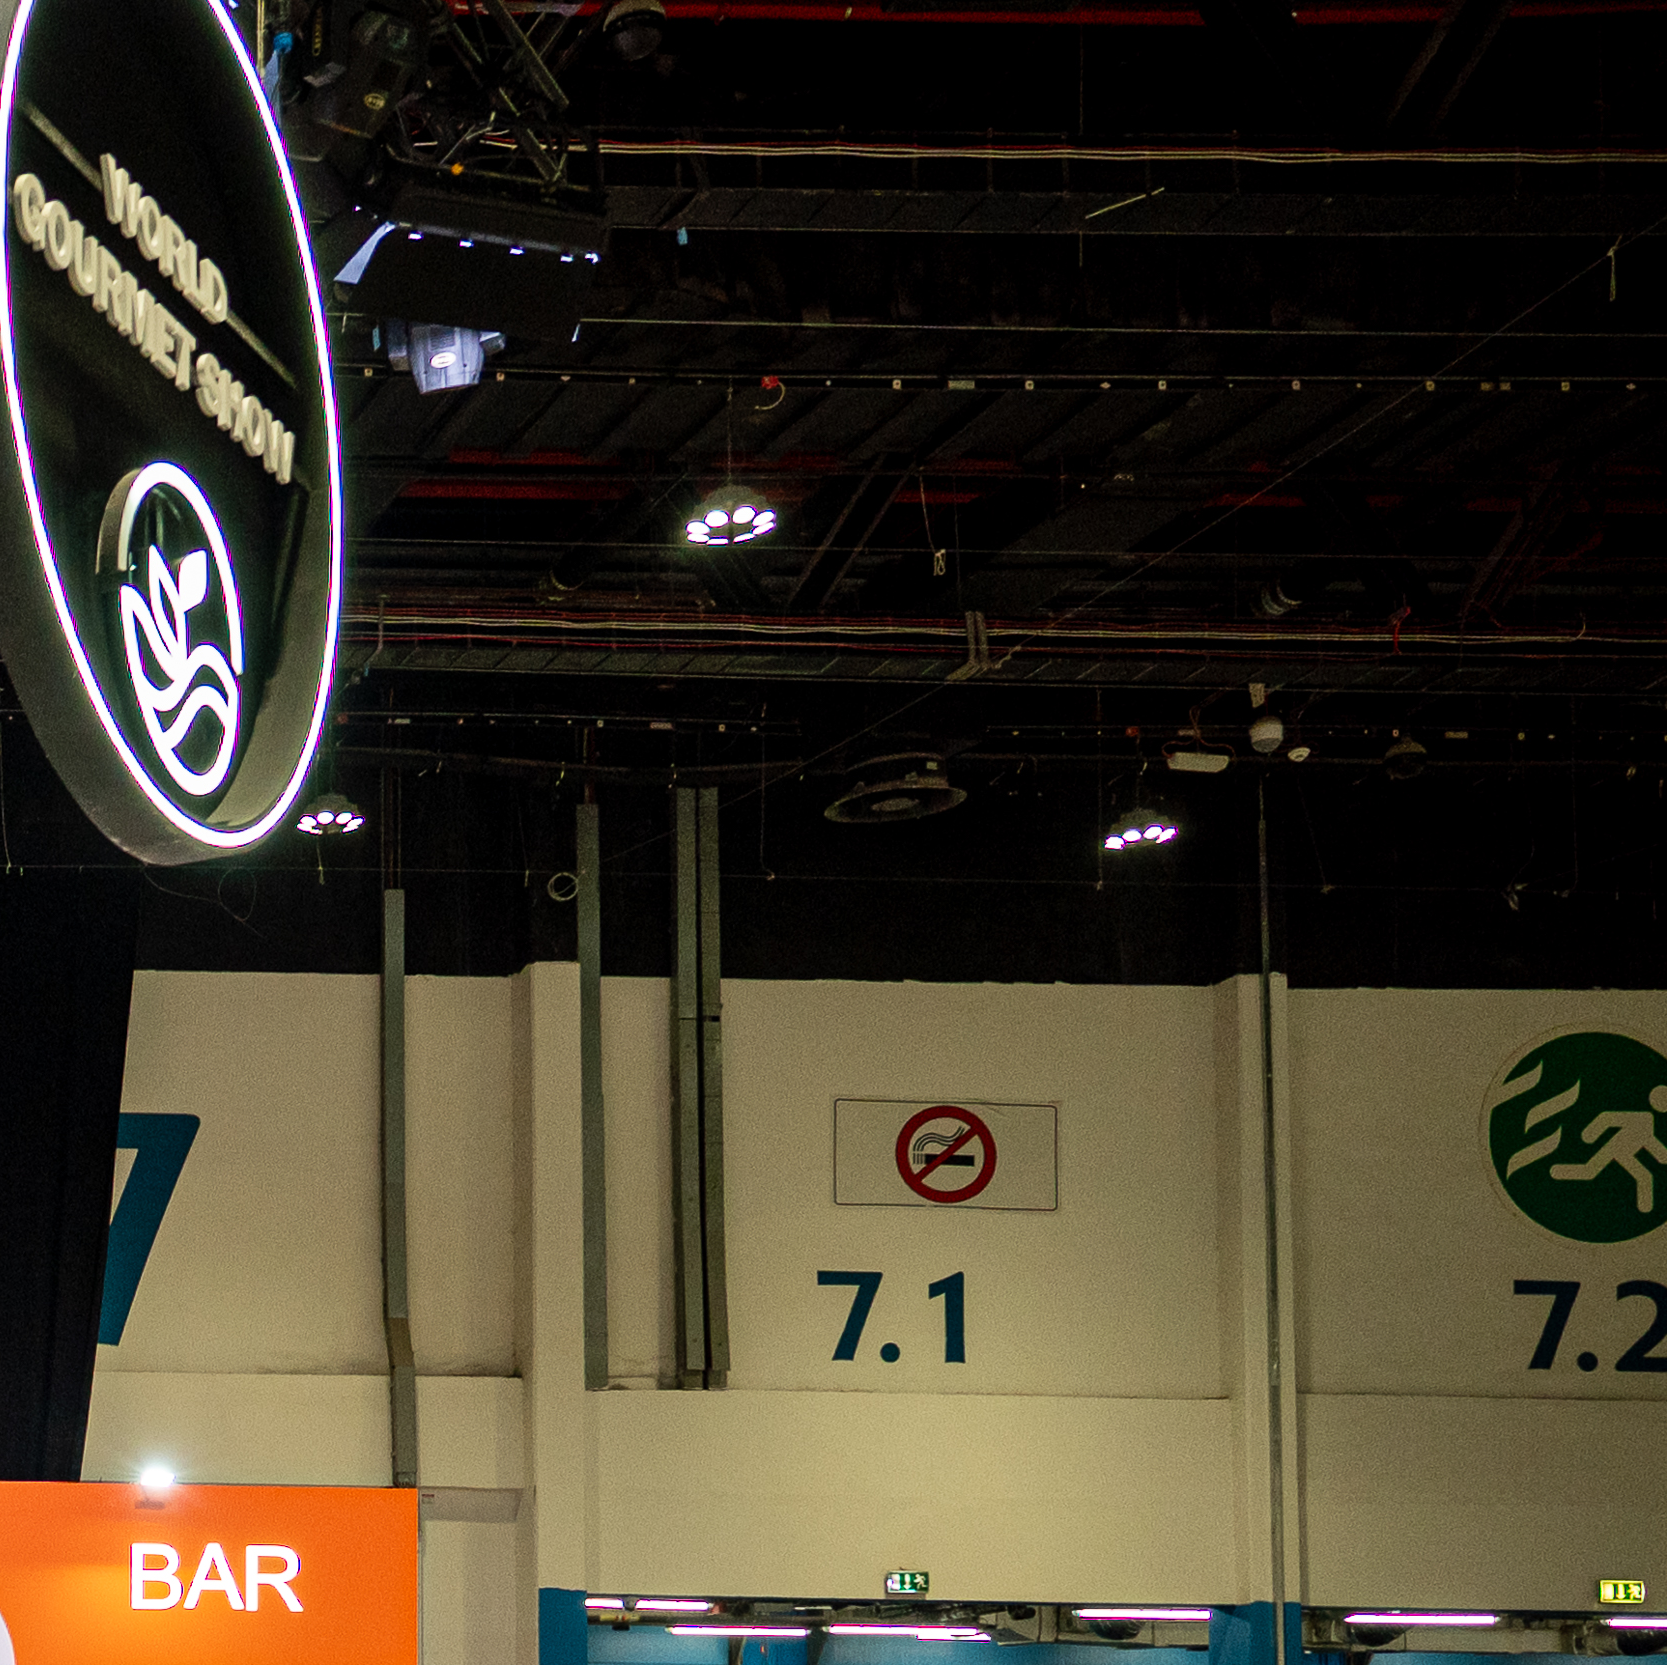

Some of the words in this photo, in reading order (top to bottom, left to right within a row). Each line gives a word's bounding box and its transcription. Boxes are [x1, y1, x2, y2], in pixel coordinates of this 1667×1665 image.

[99, 152, 228, 325] WORLD
[13, 173, 197, 391] GOURMET
[195, 353, 295, 485] SHOW
[97, 1112, 201, 1346] 7
[817, 1270, 966, 1364] 7.1
[1513, 1279, 1667, 1373] 7.2
[129, 1542, 304, 1613] BAR
